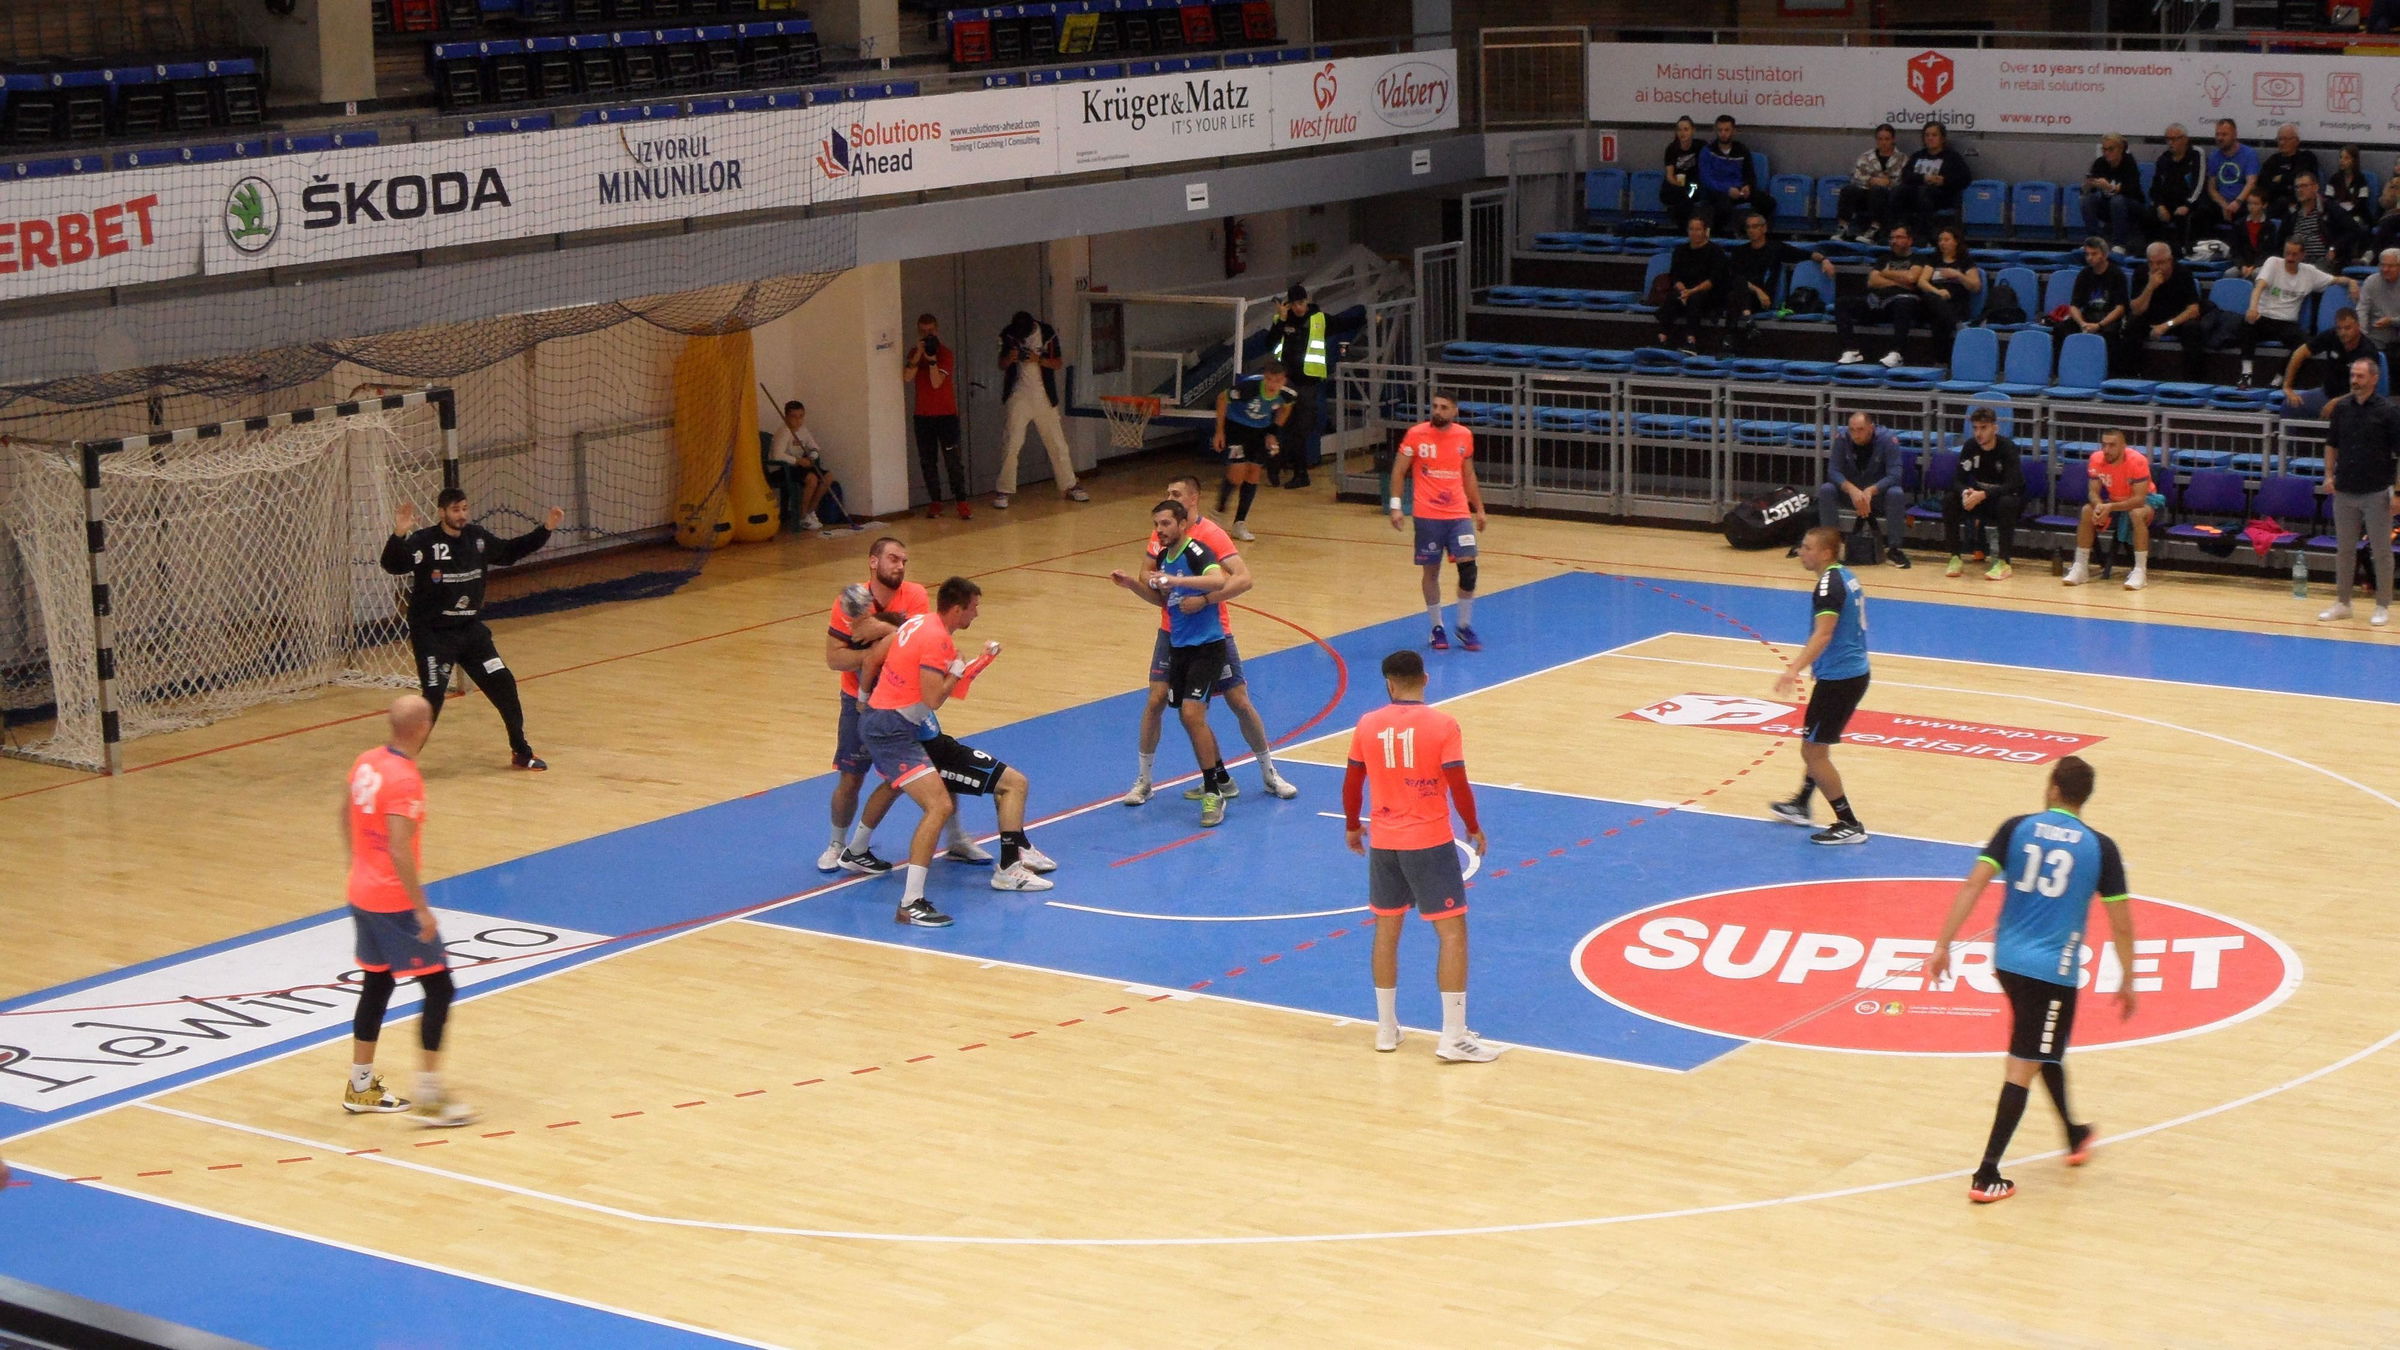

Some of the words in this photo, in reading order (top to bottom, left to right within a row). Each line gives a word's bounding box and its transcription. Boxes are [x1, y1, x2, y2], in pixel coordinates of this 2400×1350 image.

[1657, 62, 1712, 81] Mândri
[2001, 62, 2028, 74] Over
[2032, 64, 2046, 74] 10
[2050, 64, 2084, 77] years
[2088, 63, 2099, 74] of
[2104, 63, 2172, 76] innovation
[1377, 72, 1448, 114] Valvery
[1635, 88, 1649, 102] ai
[1654, 86, 1748, 105] baschetului
[1755, 89, 1825, 107] orădean
[2001, 79, 2011, 89] in
[2014, 79, 2045, 91] retail
[2048, 80, 2105, 93] solutions
[1082, 79, 1249, 130] Krüger&Matz
[950, 119, 1041, 137] www.solutions-ahead.com
[1171, 118, 1192, 135] IT'S
[1196, 116, 1227, 132] YOUR
[1231, 113, 1255, 129] LIFE
[1290, 114, 1322, 140] West
[1886, 108, 1975, 129] advertising
[2001, 113, 2072, 126] www.rxp.ro
[850, 119, 942, 148] Solutions
[950, 143, 973, 153] Training
[977, 139, 1004, 151] Coaching
[1008, 135, 1041, 147] Consulting
[636, 135, 711, 163] IZVORUL
[851, 148, 913, 177] Ahead
[599, 159, 742, 206] MINUNILOR
[302, 168, 512, 230] ŠKODA
[1418, 443, 1437, 458] 81
[1762, 493, 1810, 525] SELECT
[432, 543, 452, 560] 12
[1893, 715, 2080, 744] www.rxp.ro
[1377, 727, 1415, 768] 11
[2014, 843, 2074, 898] 13
